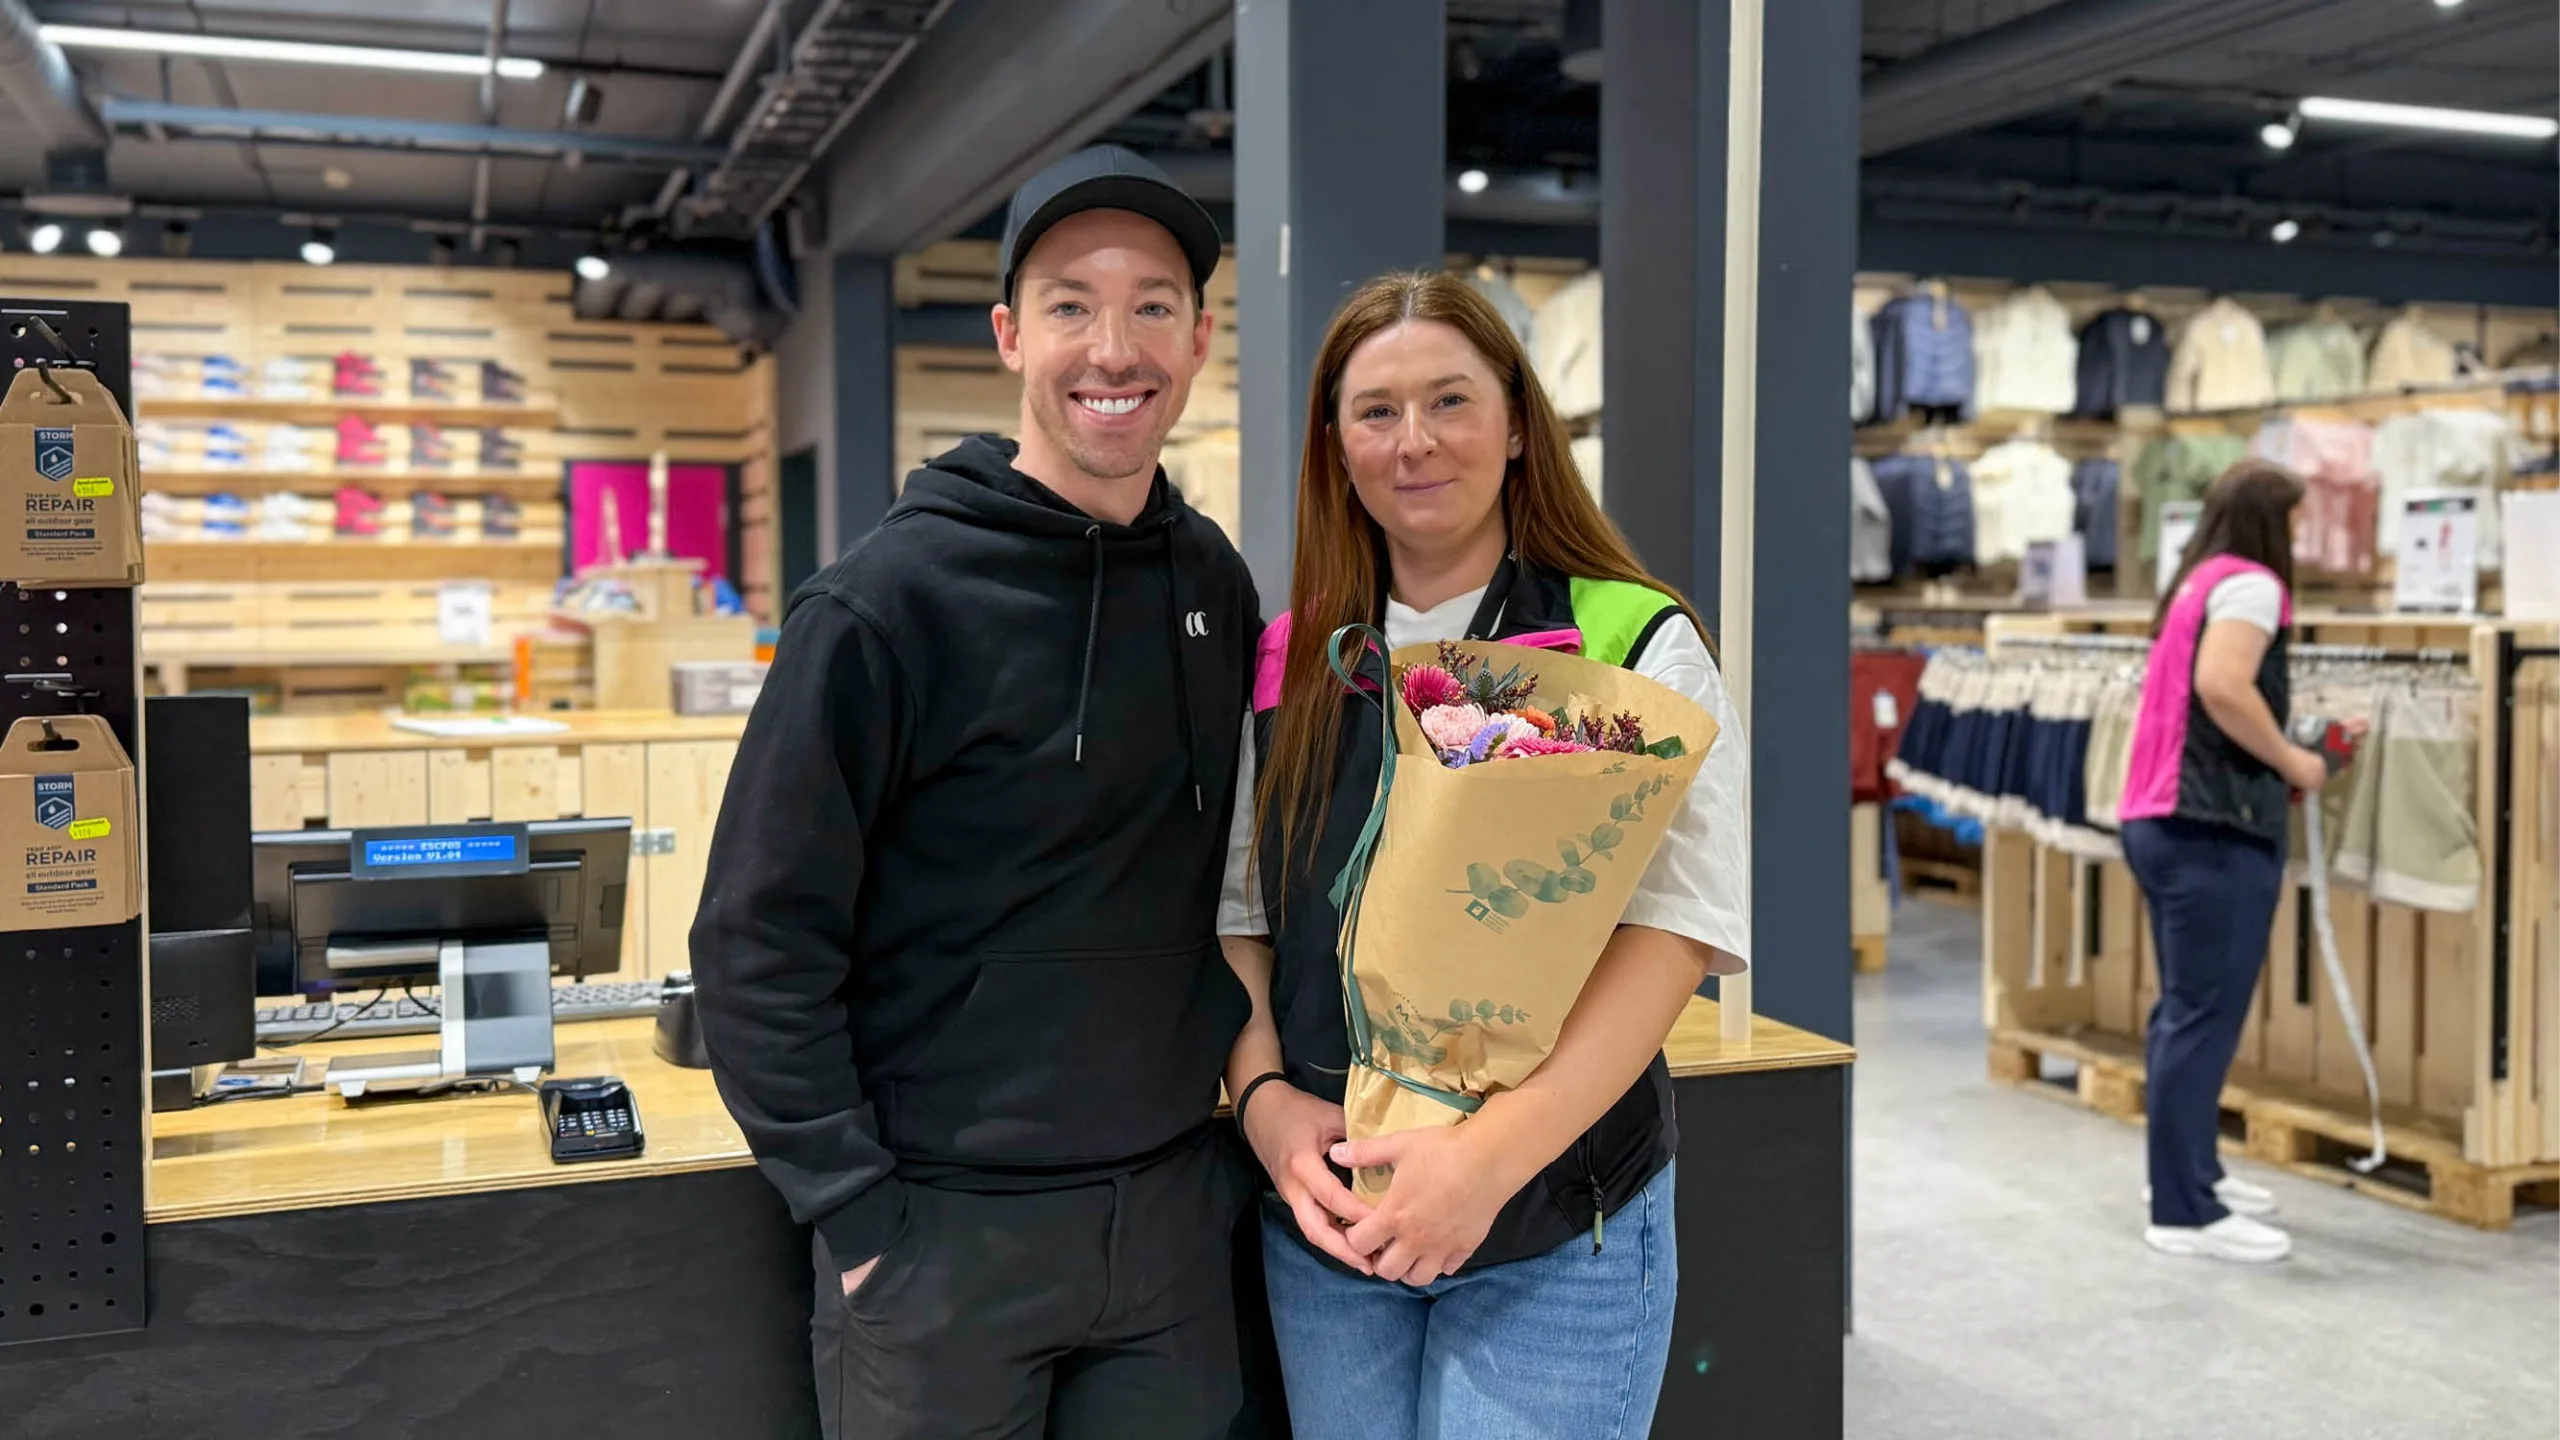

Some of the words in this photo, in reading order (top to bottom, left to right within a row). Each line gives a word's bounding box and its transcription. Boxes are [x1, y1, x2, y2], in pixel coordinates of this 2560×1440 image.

[40, 431, 74, 440] STORM
[26, 499, 95, 512] REPAIR
[25, 517, 36, 525] all
[37, 516, 71, 525] outdoor
[73, 517, 93, 526] gear
[35, 530, 68, 538] Standard
[70, 530, 88, 538] Pack
[37, 782, 72, 791] STORM
[26, 849, 96, 865] REPAIR
[372, 853, 423, 863] Version
[25, 871, 37, 879] all
[38, 868, 73, 878] outdoor
[75, 868, 95, 878] gear
[35, 883, 70, 892] Standard
[71, 881, 89, 890] Pack
